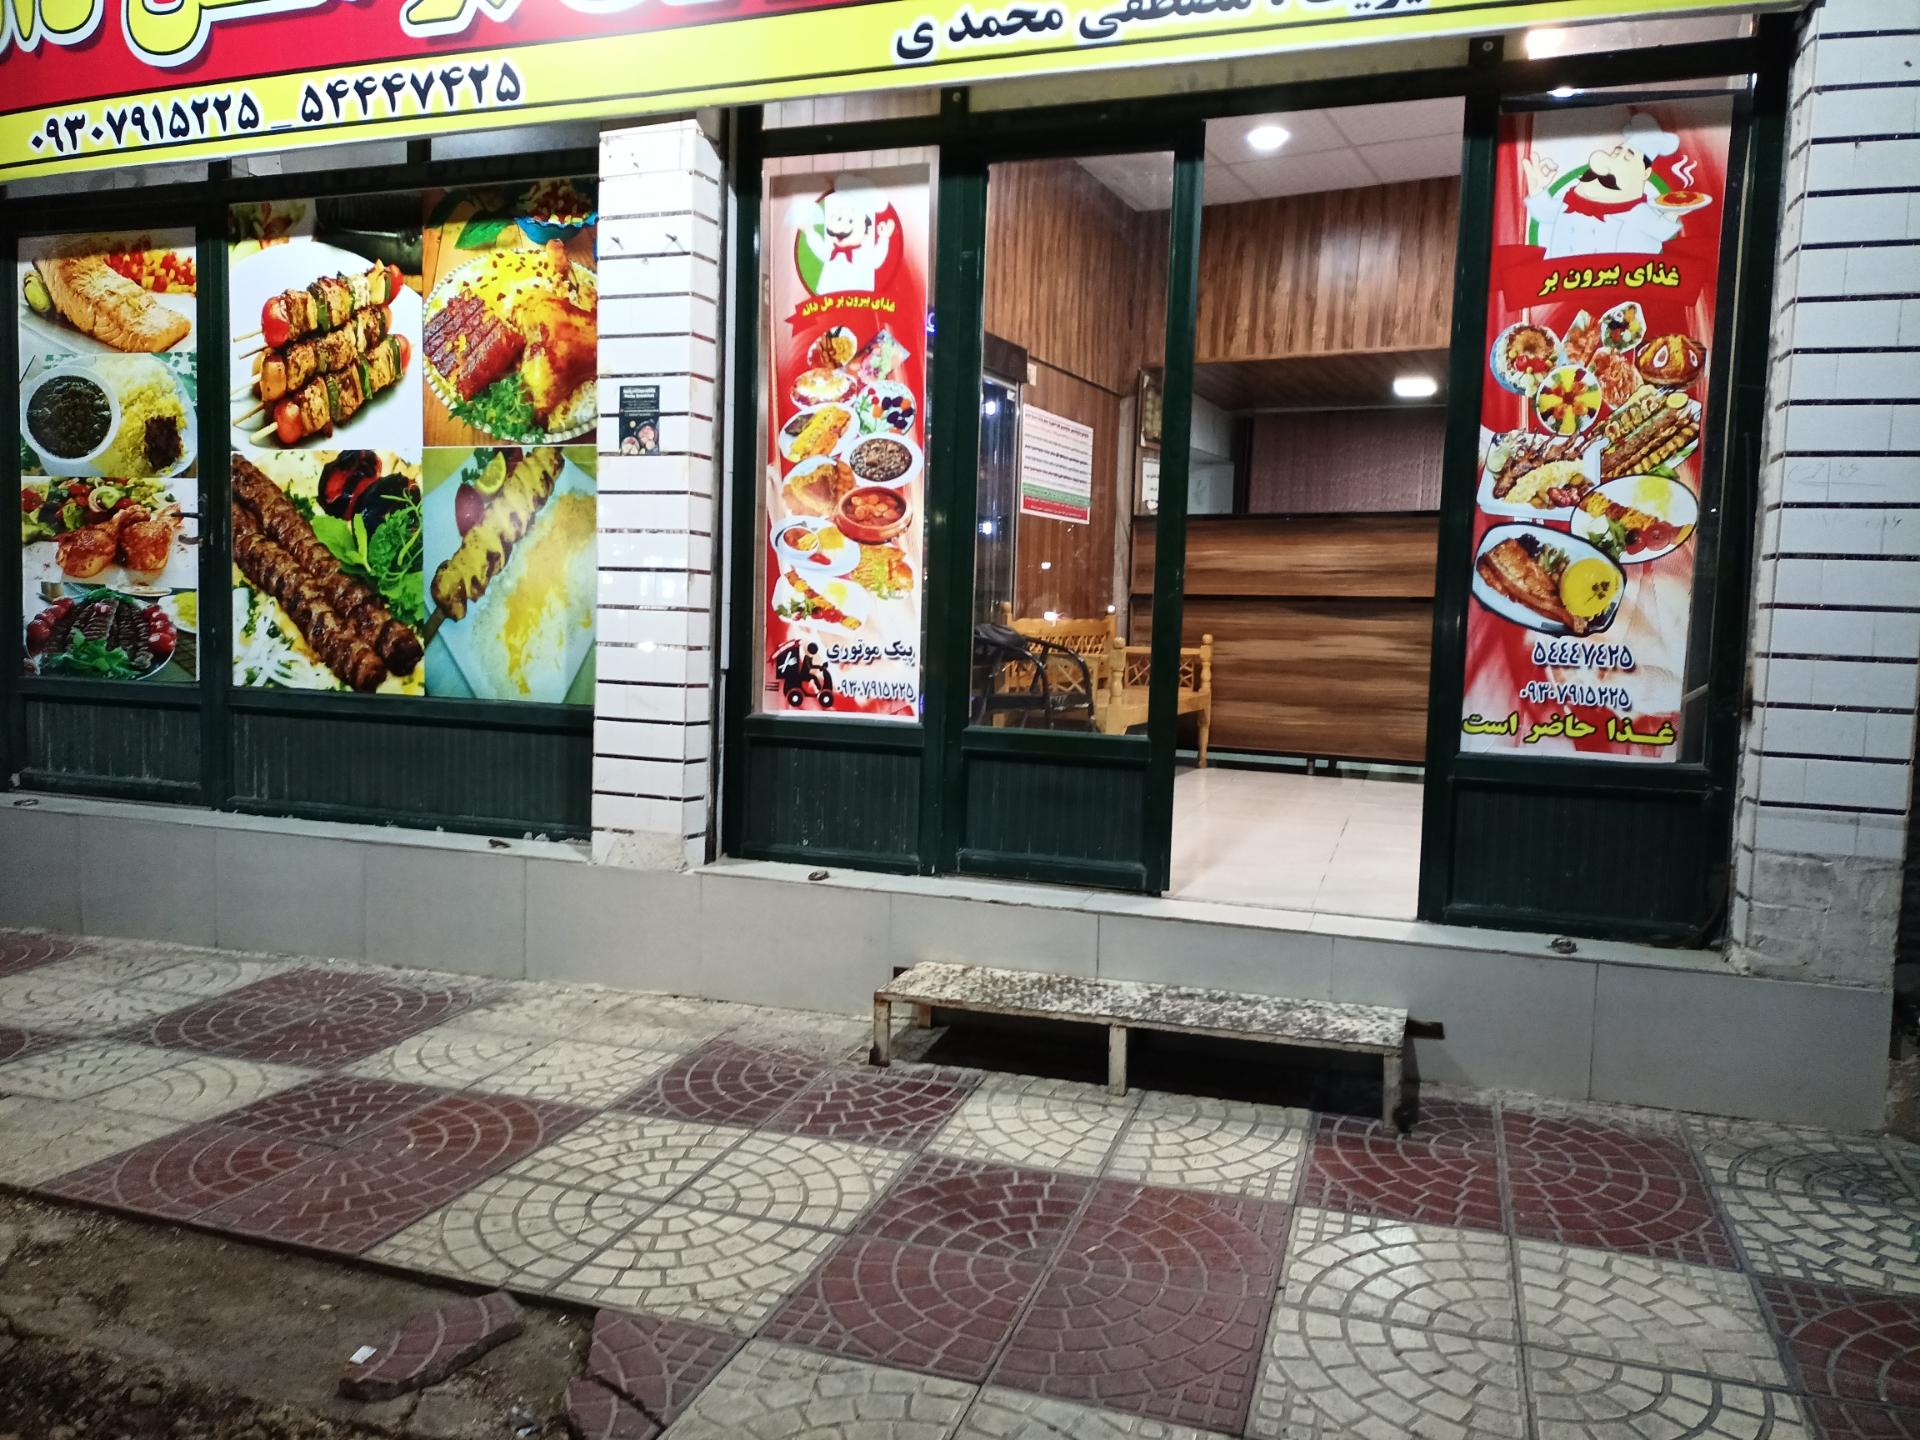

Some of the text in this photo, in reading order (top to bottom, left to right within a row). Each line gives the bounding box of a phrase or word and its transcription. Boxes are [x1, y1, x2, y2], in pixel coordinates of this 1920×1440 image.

[301, 61, 521, 123] ۵۴۴۴۷۴۲۵
[1537, 261, 1680, 297] غذای بیرون بر
[846, 296, 871, 308] بیرون
[871, 297, 896, 312] غذای
[826, 639, 880, 661] موتوری
[1521, 681, 1630, 707] ۰۹۳۰۷۹۱۵۲۲۵
[1462, 712, 1519, 735] است
[1523, 713, 1596, 743] حاضر
